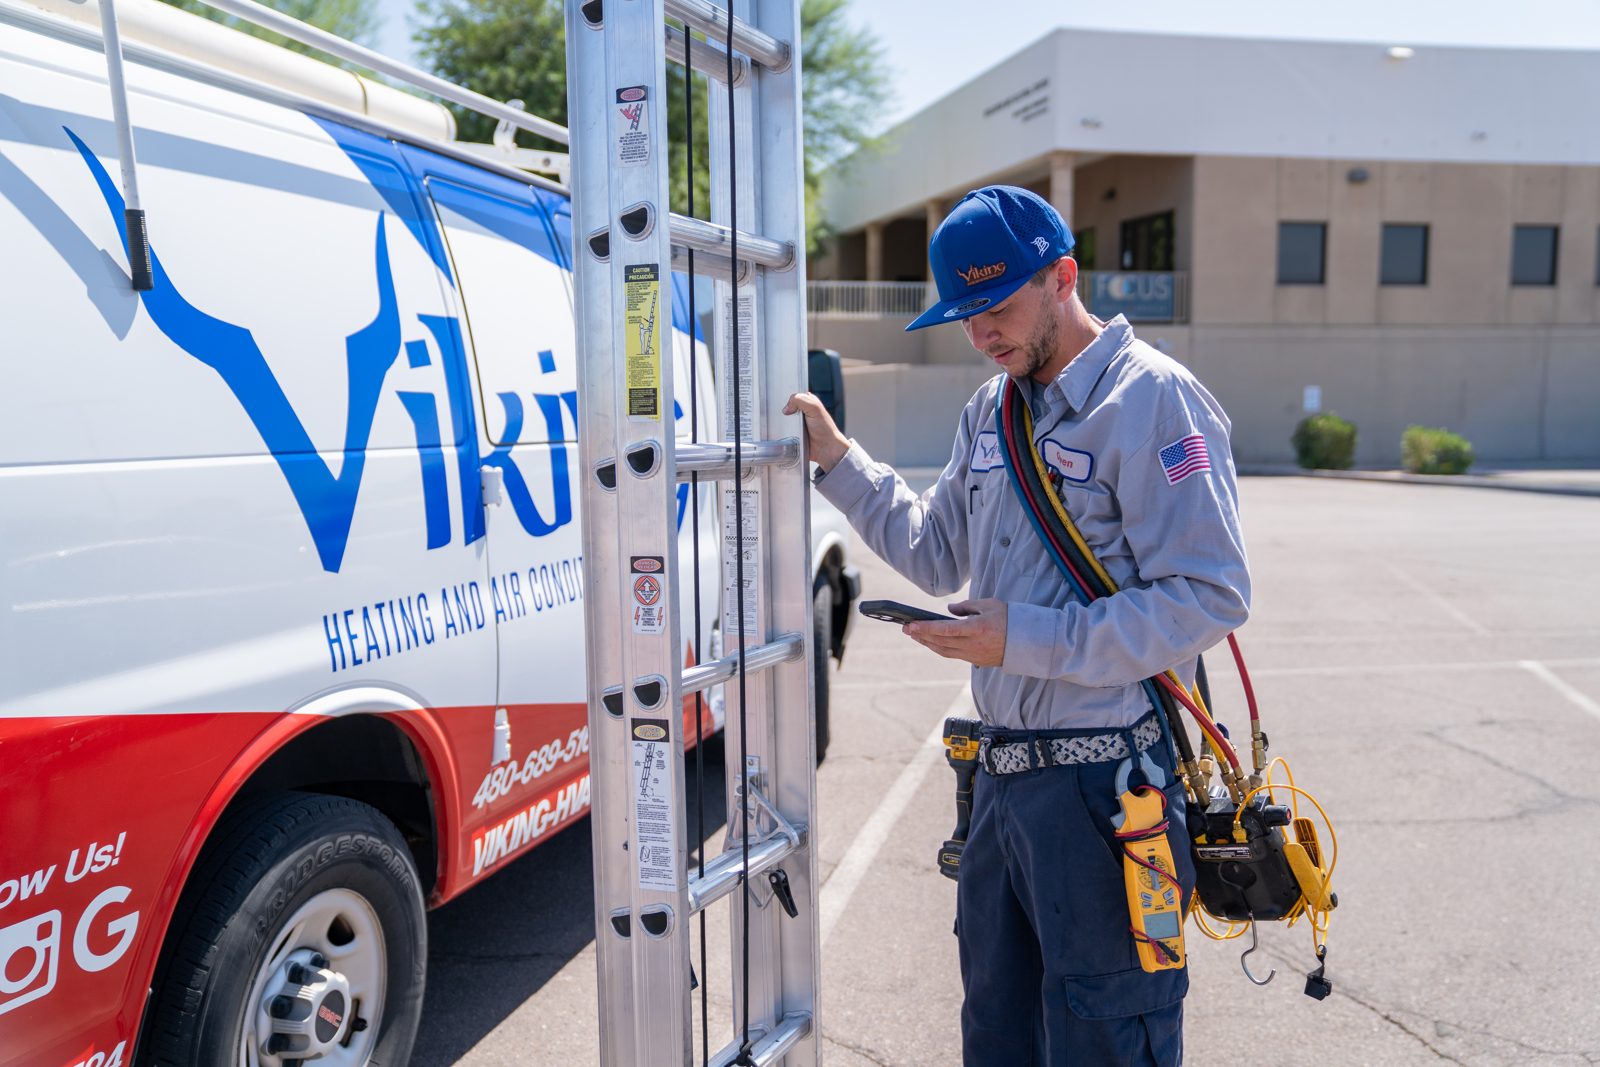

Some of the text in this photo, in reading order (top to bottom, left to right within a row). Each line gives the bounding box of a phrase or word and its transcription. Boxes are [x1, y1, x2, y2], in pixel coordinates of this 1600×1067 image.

[956, 262, 1006, 281] Viking
[1097, 274, 1169, 300] FOCUS
[323, 592, 435, 672] HEATING
[441, 581, 486, 639] AND
[491, 572, 526, 624] AIR
[64, 831, 127, 884] Us!
[319, 1005, 342, 1028] GMC
